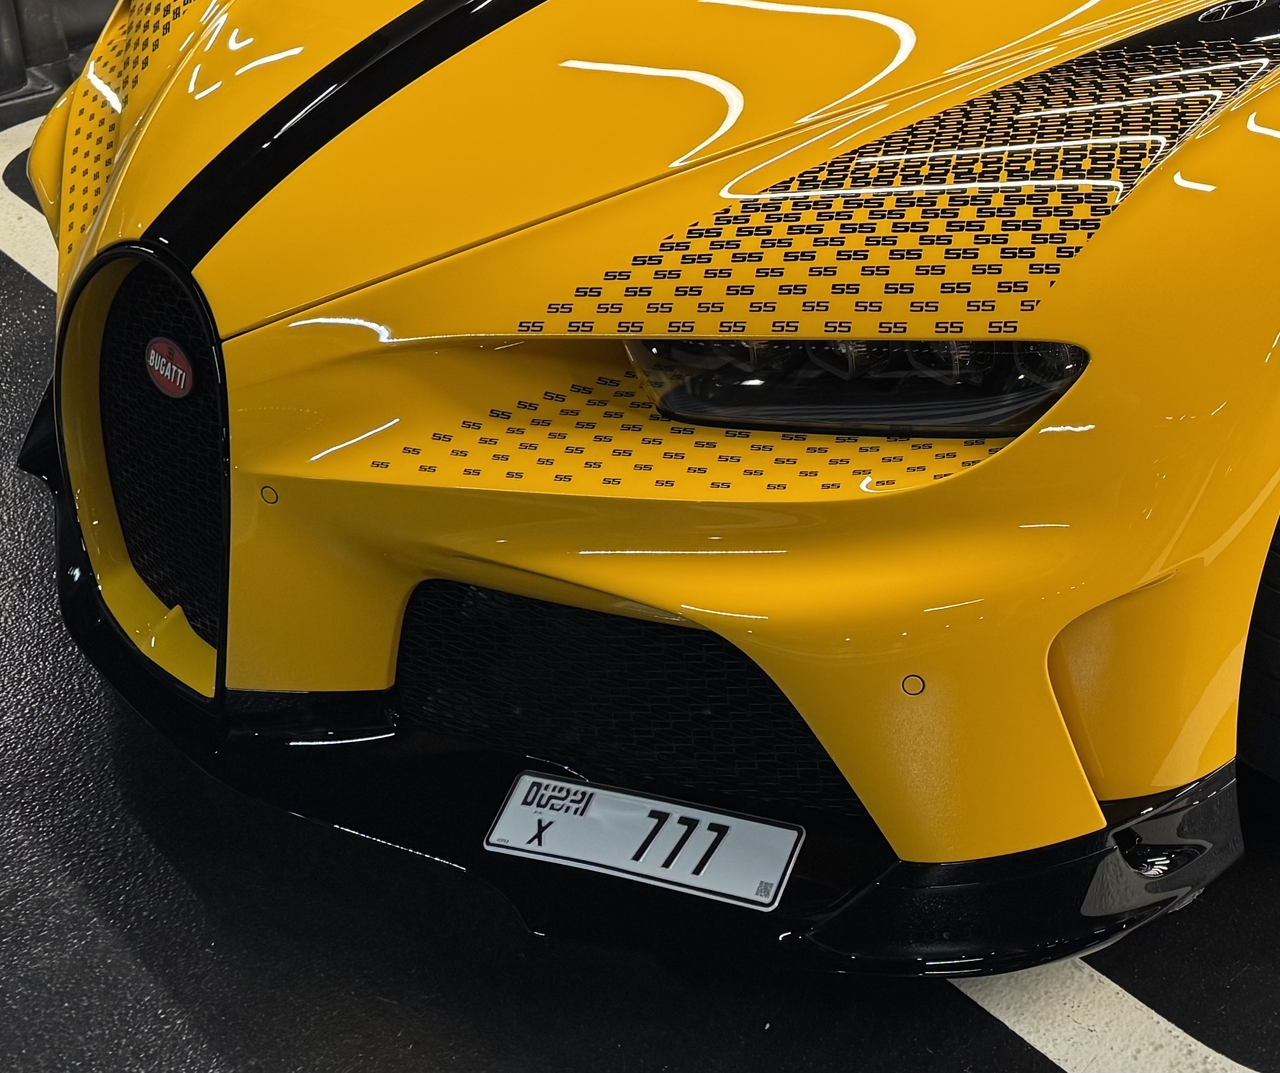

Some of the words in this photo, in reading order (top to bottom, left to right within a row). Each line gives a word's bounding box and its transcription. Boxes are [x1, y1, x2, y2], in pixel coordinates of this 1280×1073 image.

[1090, 205, 1119, 217] 5
[1019, 299, 1041, 312] 5
[149, 349, 186, 389] BUGATTI
[525, 818, 556, 847] X
[630, 809, 733, 877] 777
